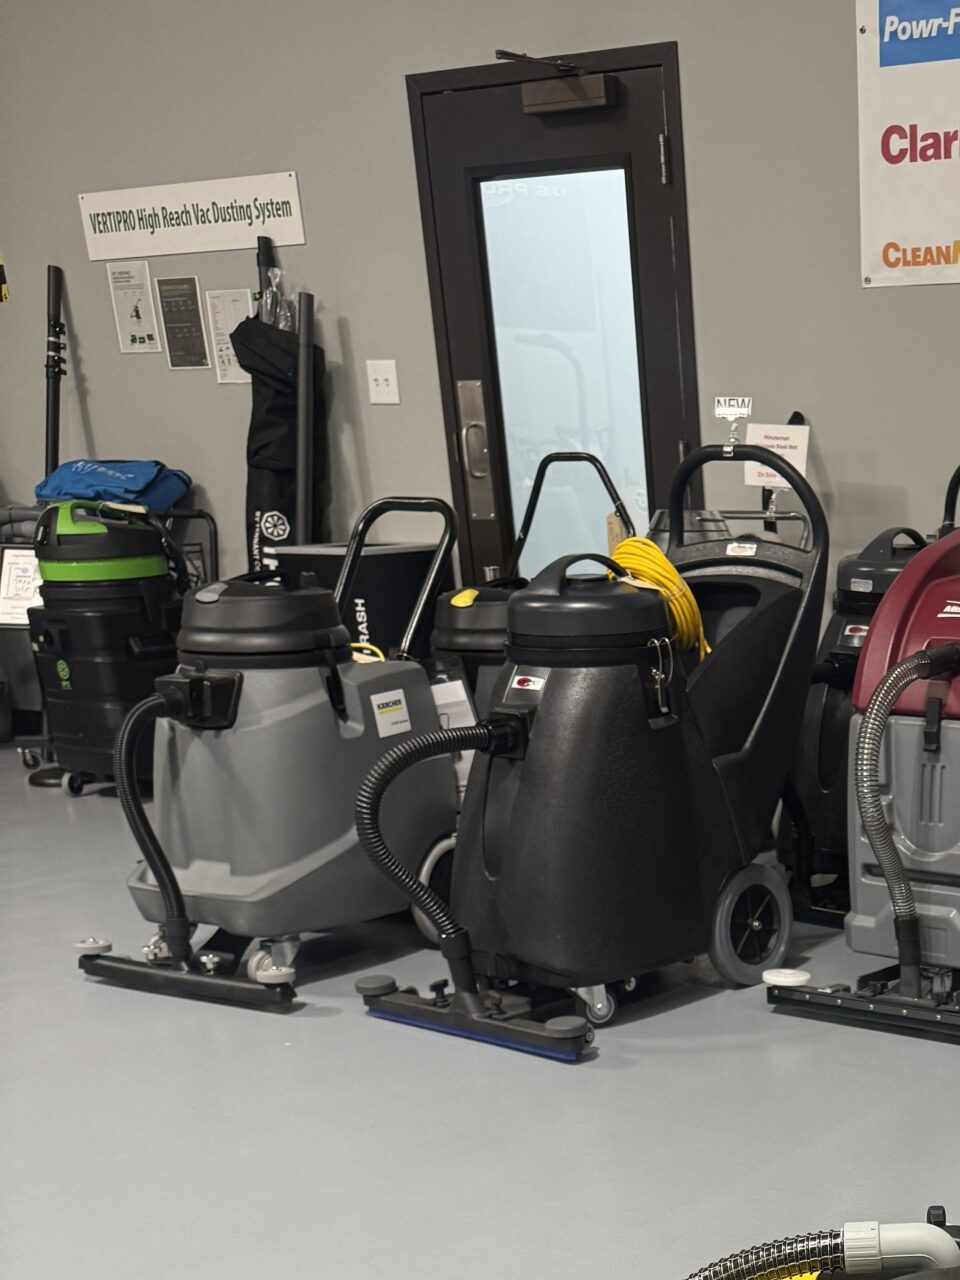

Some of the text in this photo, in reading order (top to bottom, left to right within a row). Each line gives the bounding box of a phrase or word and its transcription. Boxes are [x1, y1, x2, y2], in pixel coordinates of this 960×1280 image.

[89, 196, 293, 235] VERTIPRO High Reach Vac Dusting System
